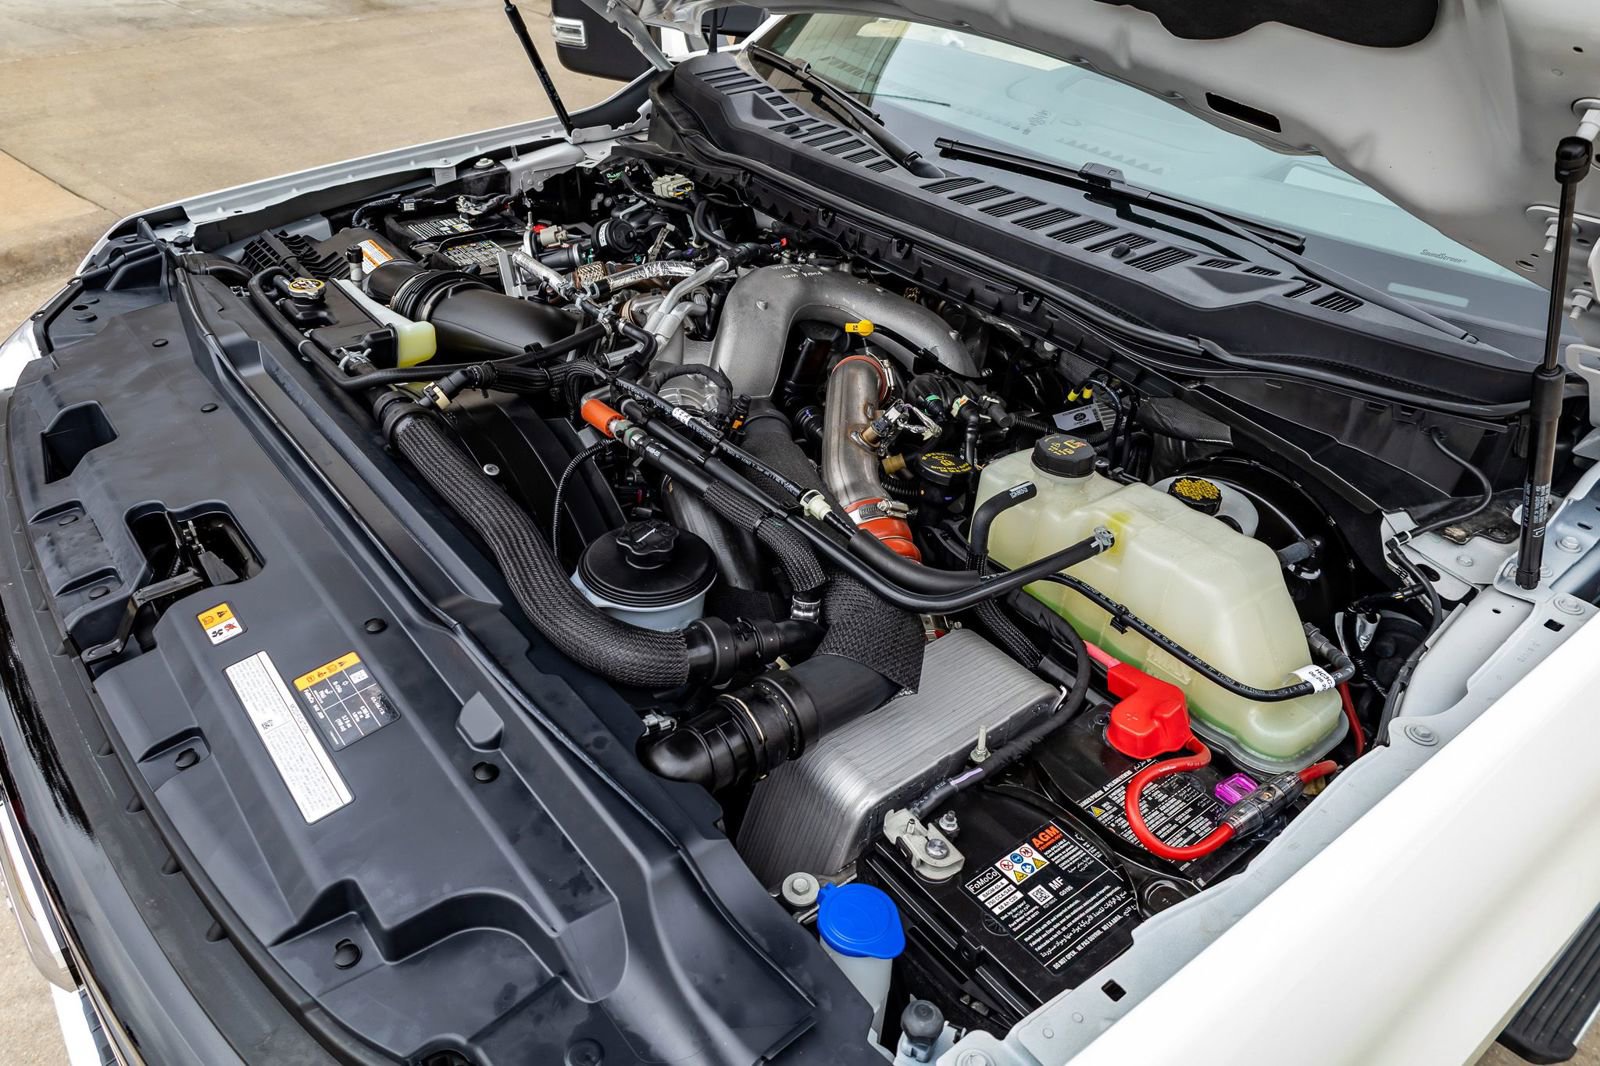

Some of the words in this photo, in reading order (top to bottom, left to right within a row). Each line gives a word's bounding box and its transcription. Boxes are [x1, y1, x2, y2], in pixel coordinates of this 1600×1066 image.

[1032, 826, 1059, 847] AGM
[969, 871, 998, 891] FoMoCo
[1049, 877, 1063, 890] MF
[1058, 957, 1067, 965] NOT
[1081, 939, 1090, 947] PAS
